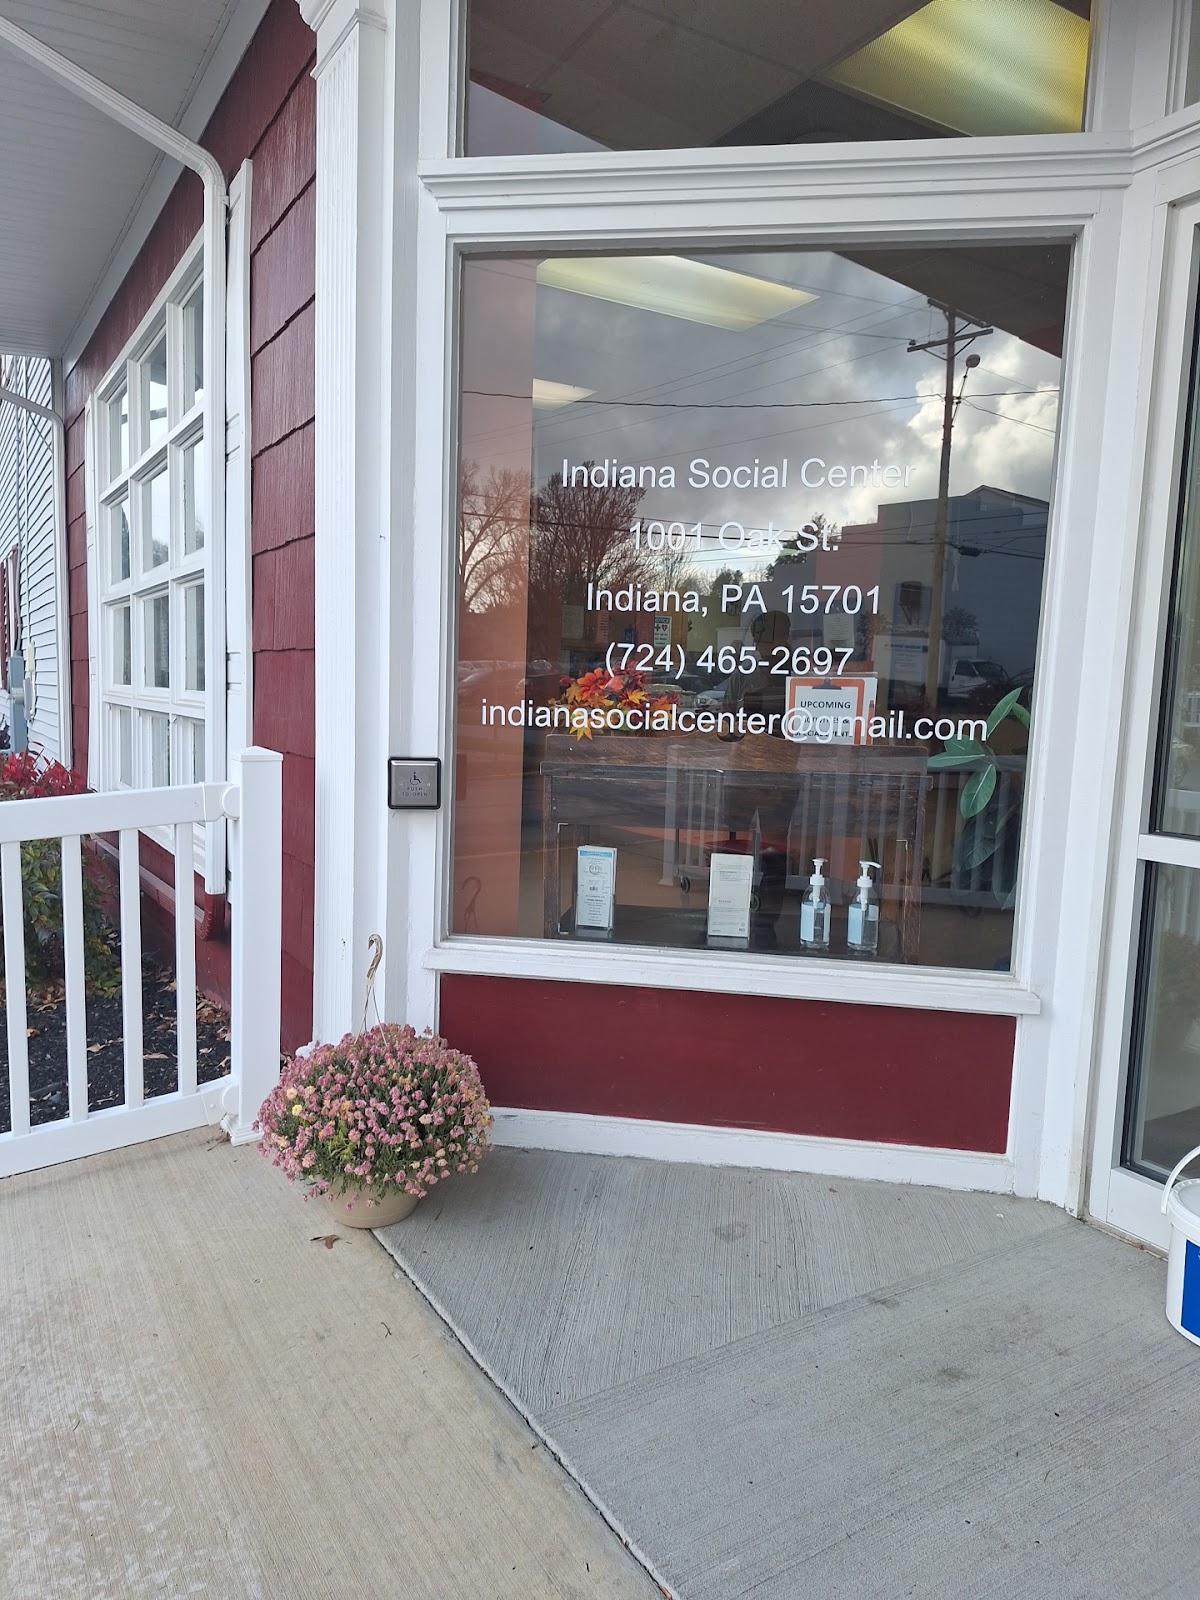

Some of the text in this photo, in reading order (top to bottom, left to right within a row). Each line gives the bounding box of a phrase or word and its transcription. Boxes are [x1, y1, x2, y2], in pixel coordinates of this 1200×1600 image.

[561, 457, 918, 489] Indiana Social Center
[629, 521, 840, 553] 1001 Oak St.
[586, 582, 880, 618] Indiana, PA 15701
[605, 641, 686, 680] (724)
[696, 644, 855, 676] 465-2697
[480, 697, 989, 744] indianasocialcenter@gmail.com
[800, 700, 851, 709] UPCOMING
